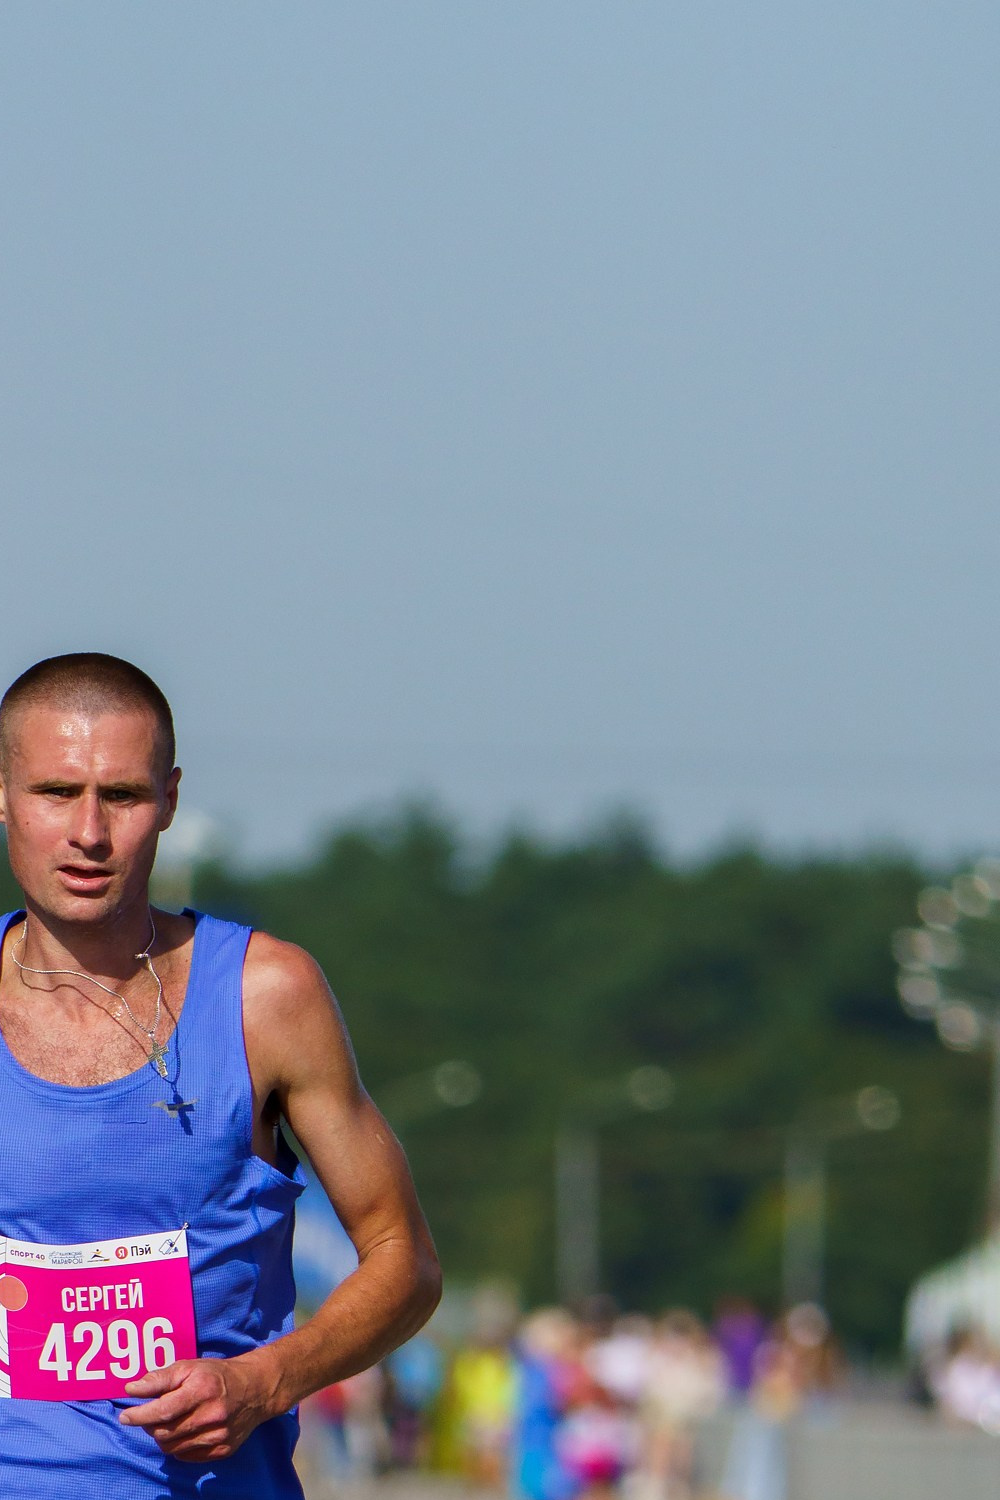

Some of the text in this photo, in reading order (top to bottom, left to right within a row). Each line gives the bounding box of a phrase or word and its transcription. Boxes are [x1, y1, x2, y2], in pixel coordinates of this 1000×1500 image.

[10, 1249, 35, 1258] СПОРТ
[131, 1244, 152, 1256] Пэй
[61, 1279, 143, 1312] СЕРГЕЙ
[38, 1317, 176, 1382] 4296
